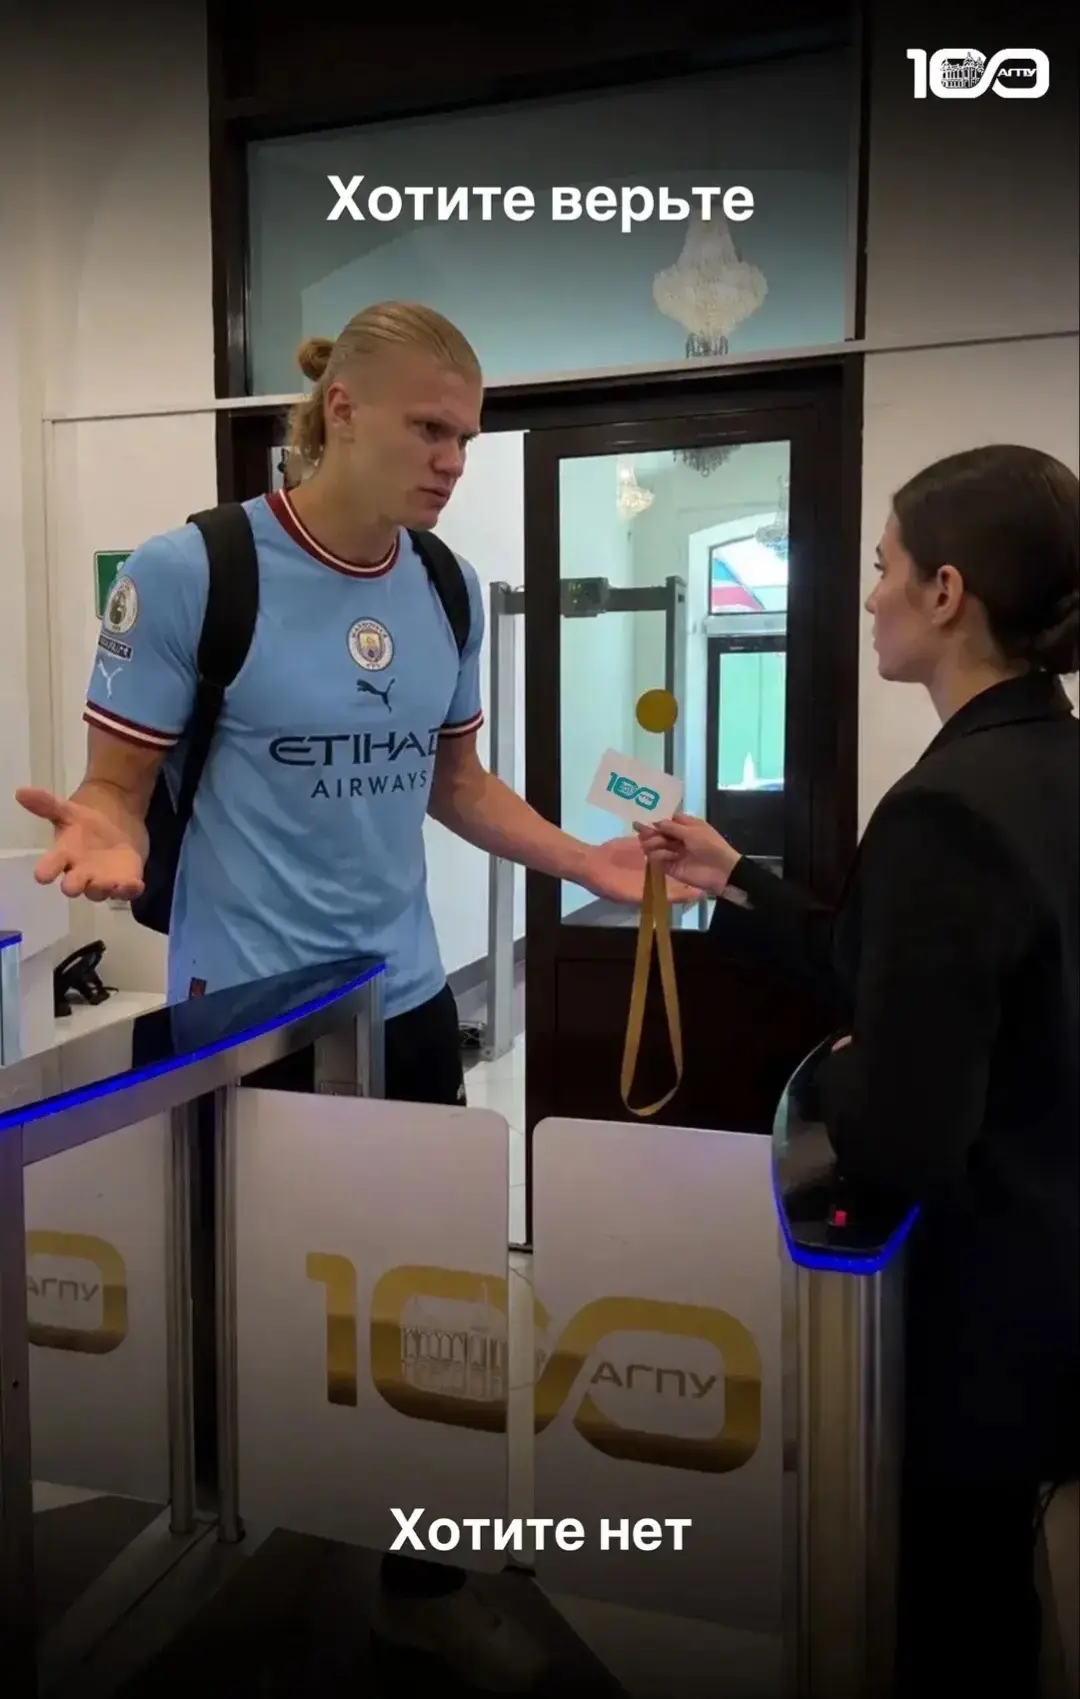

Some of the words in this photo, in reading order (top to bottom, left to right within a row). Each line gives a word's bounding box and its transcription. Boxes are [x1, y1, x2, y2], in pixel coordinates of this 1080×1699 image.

[310, 769, 428, 799] AIRWAYS
[305, 1251, 762, 1475] 100
[589, 1360, 717, 1399] АГПУ
